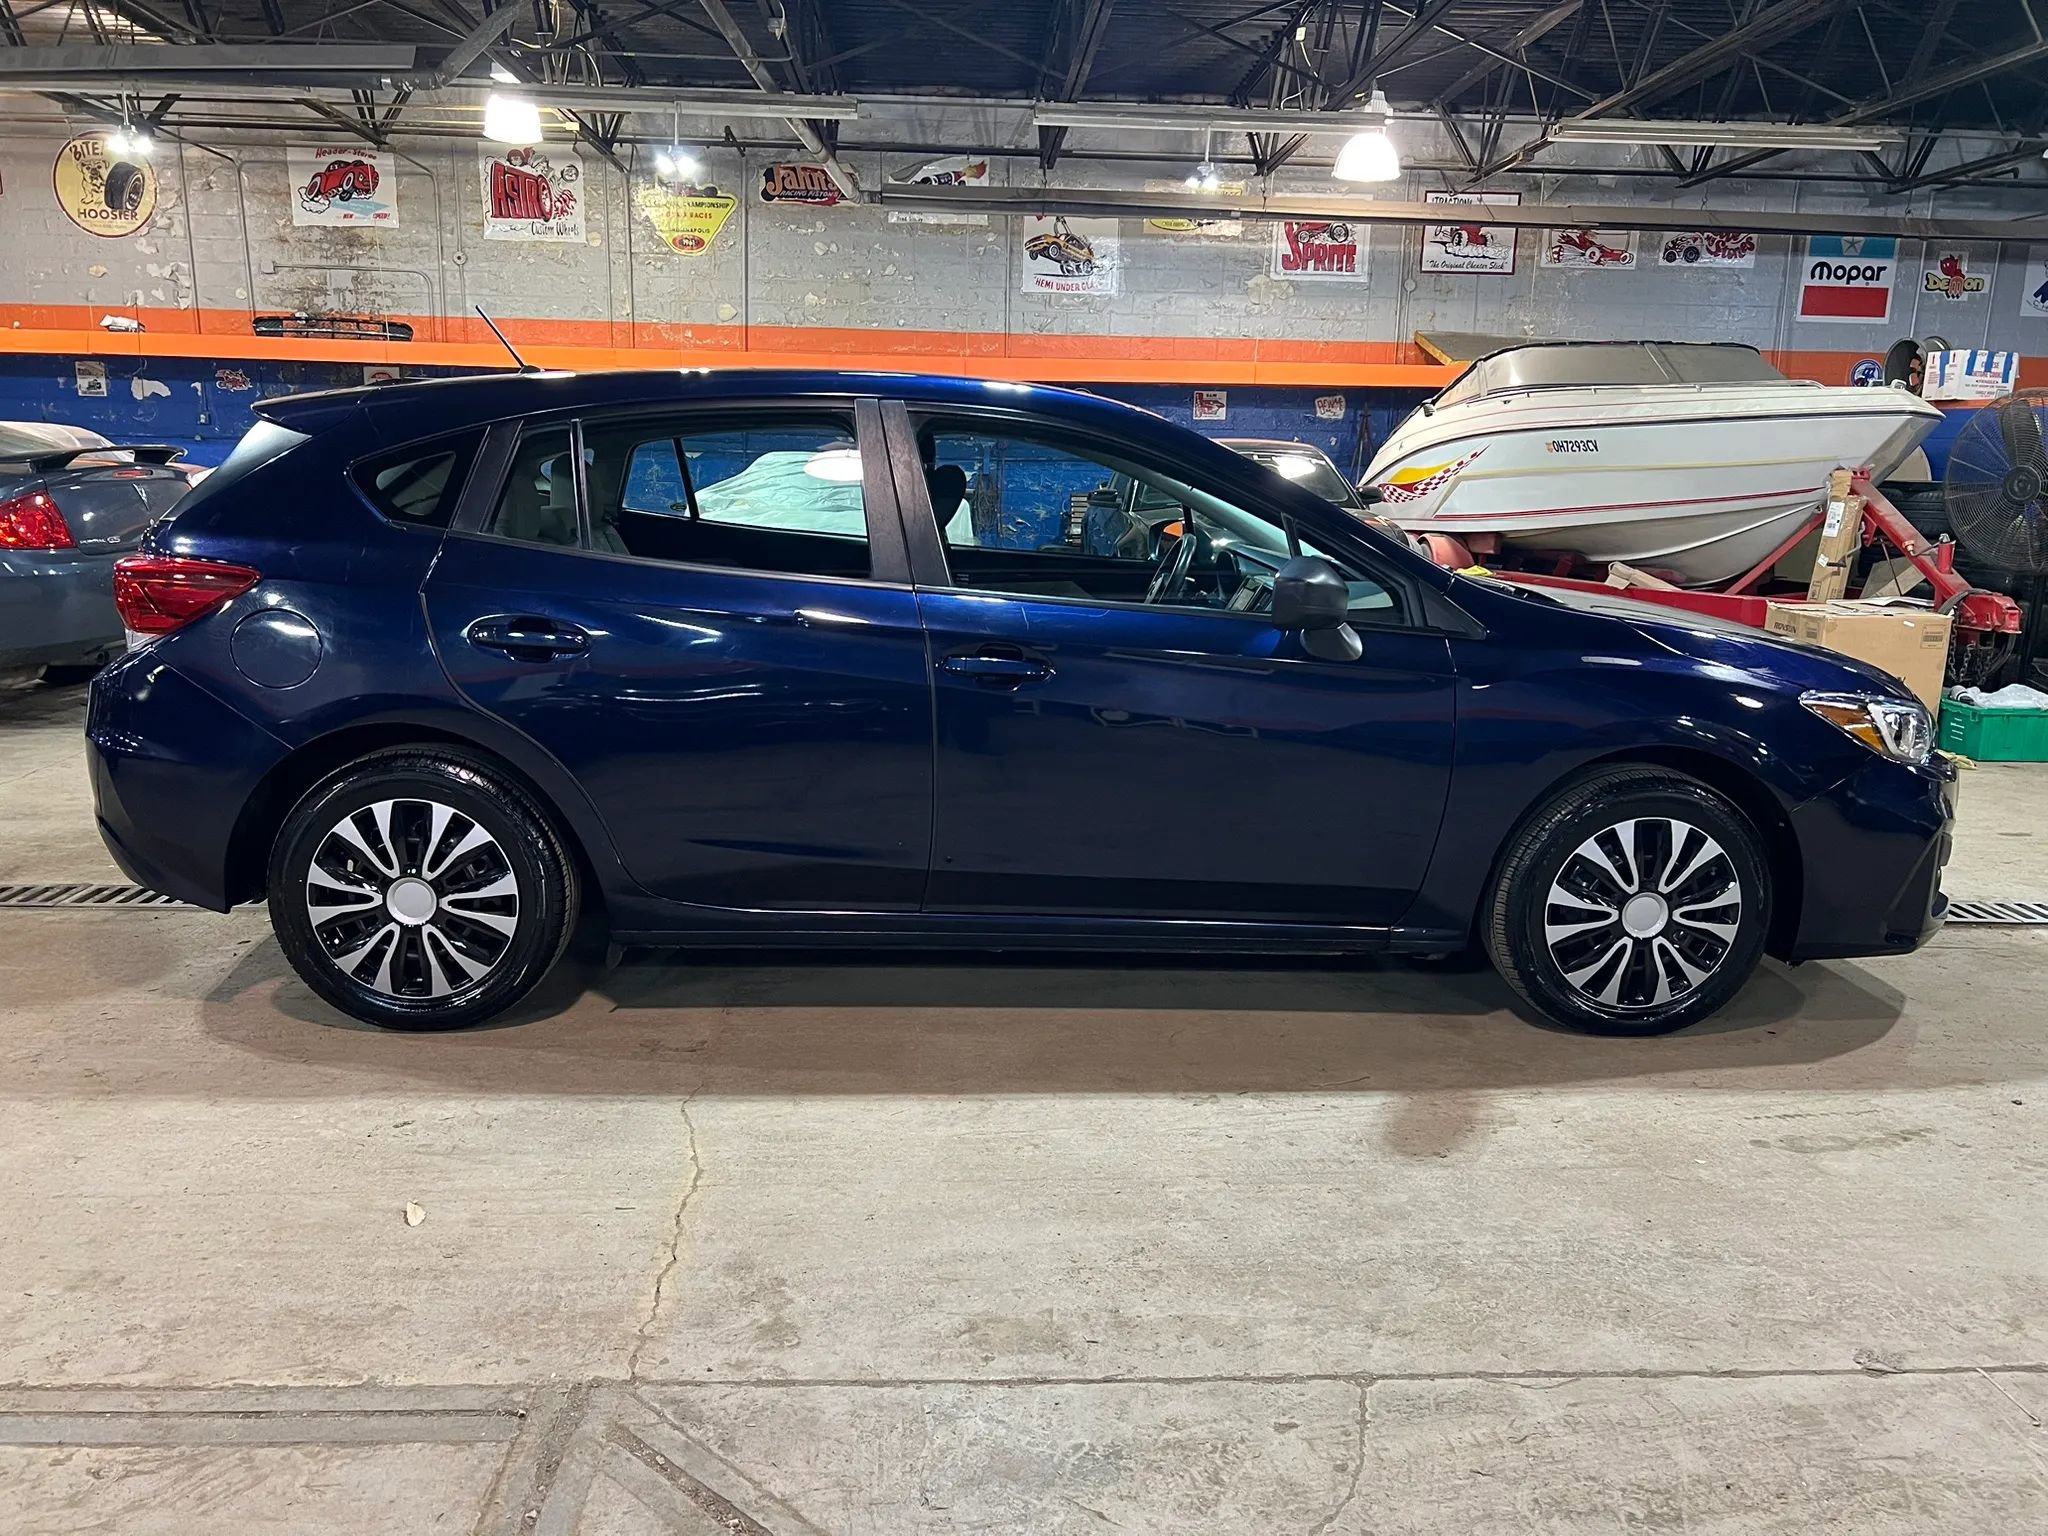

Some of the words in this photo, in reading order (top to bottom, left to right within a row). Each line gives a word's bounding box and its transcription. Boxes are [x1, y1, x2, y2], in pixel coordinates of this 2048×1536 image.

[491, 162, 553, 221] ASTRO
[77, 208, 139, 220] HOOSIER
[1440, 261, 1465, 270] Original
[1055, 282, 1080, 291] UNDER
[1552, 440, 1599, 453] OH7293CV
